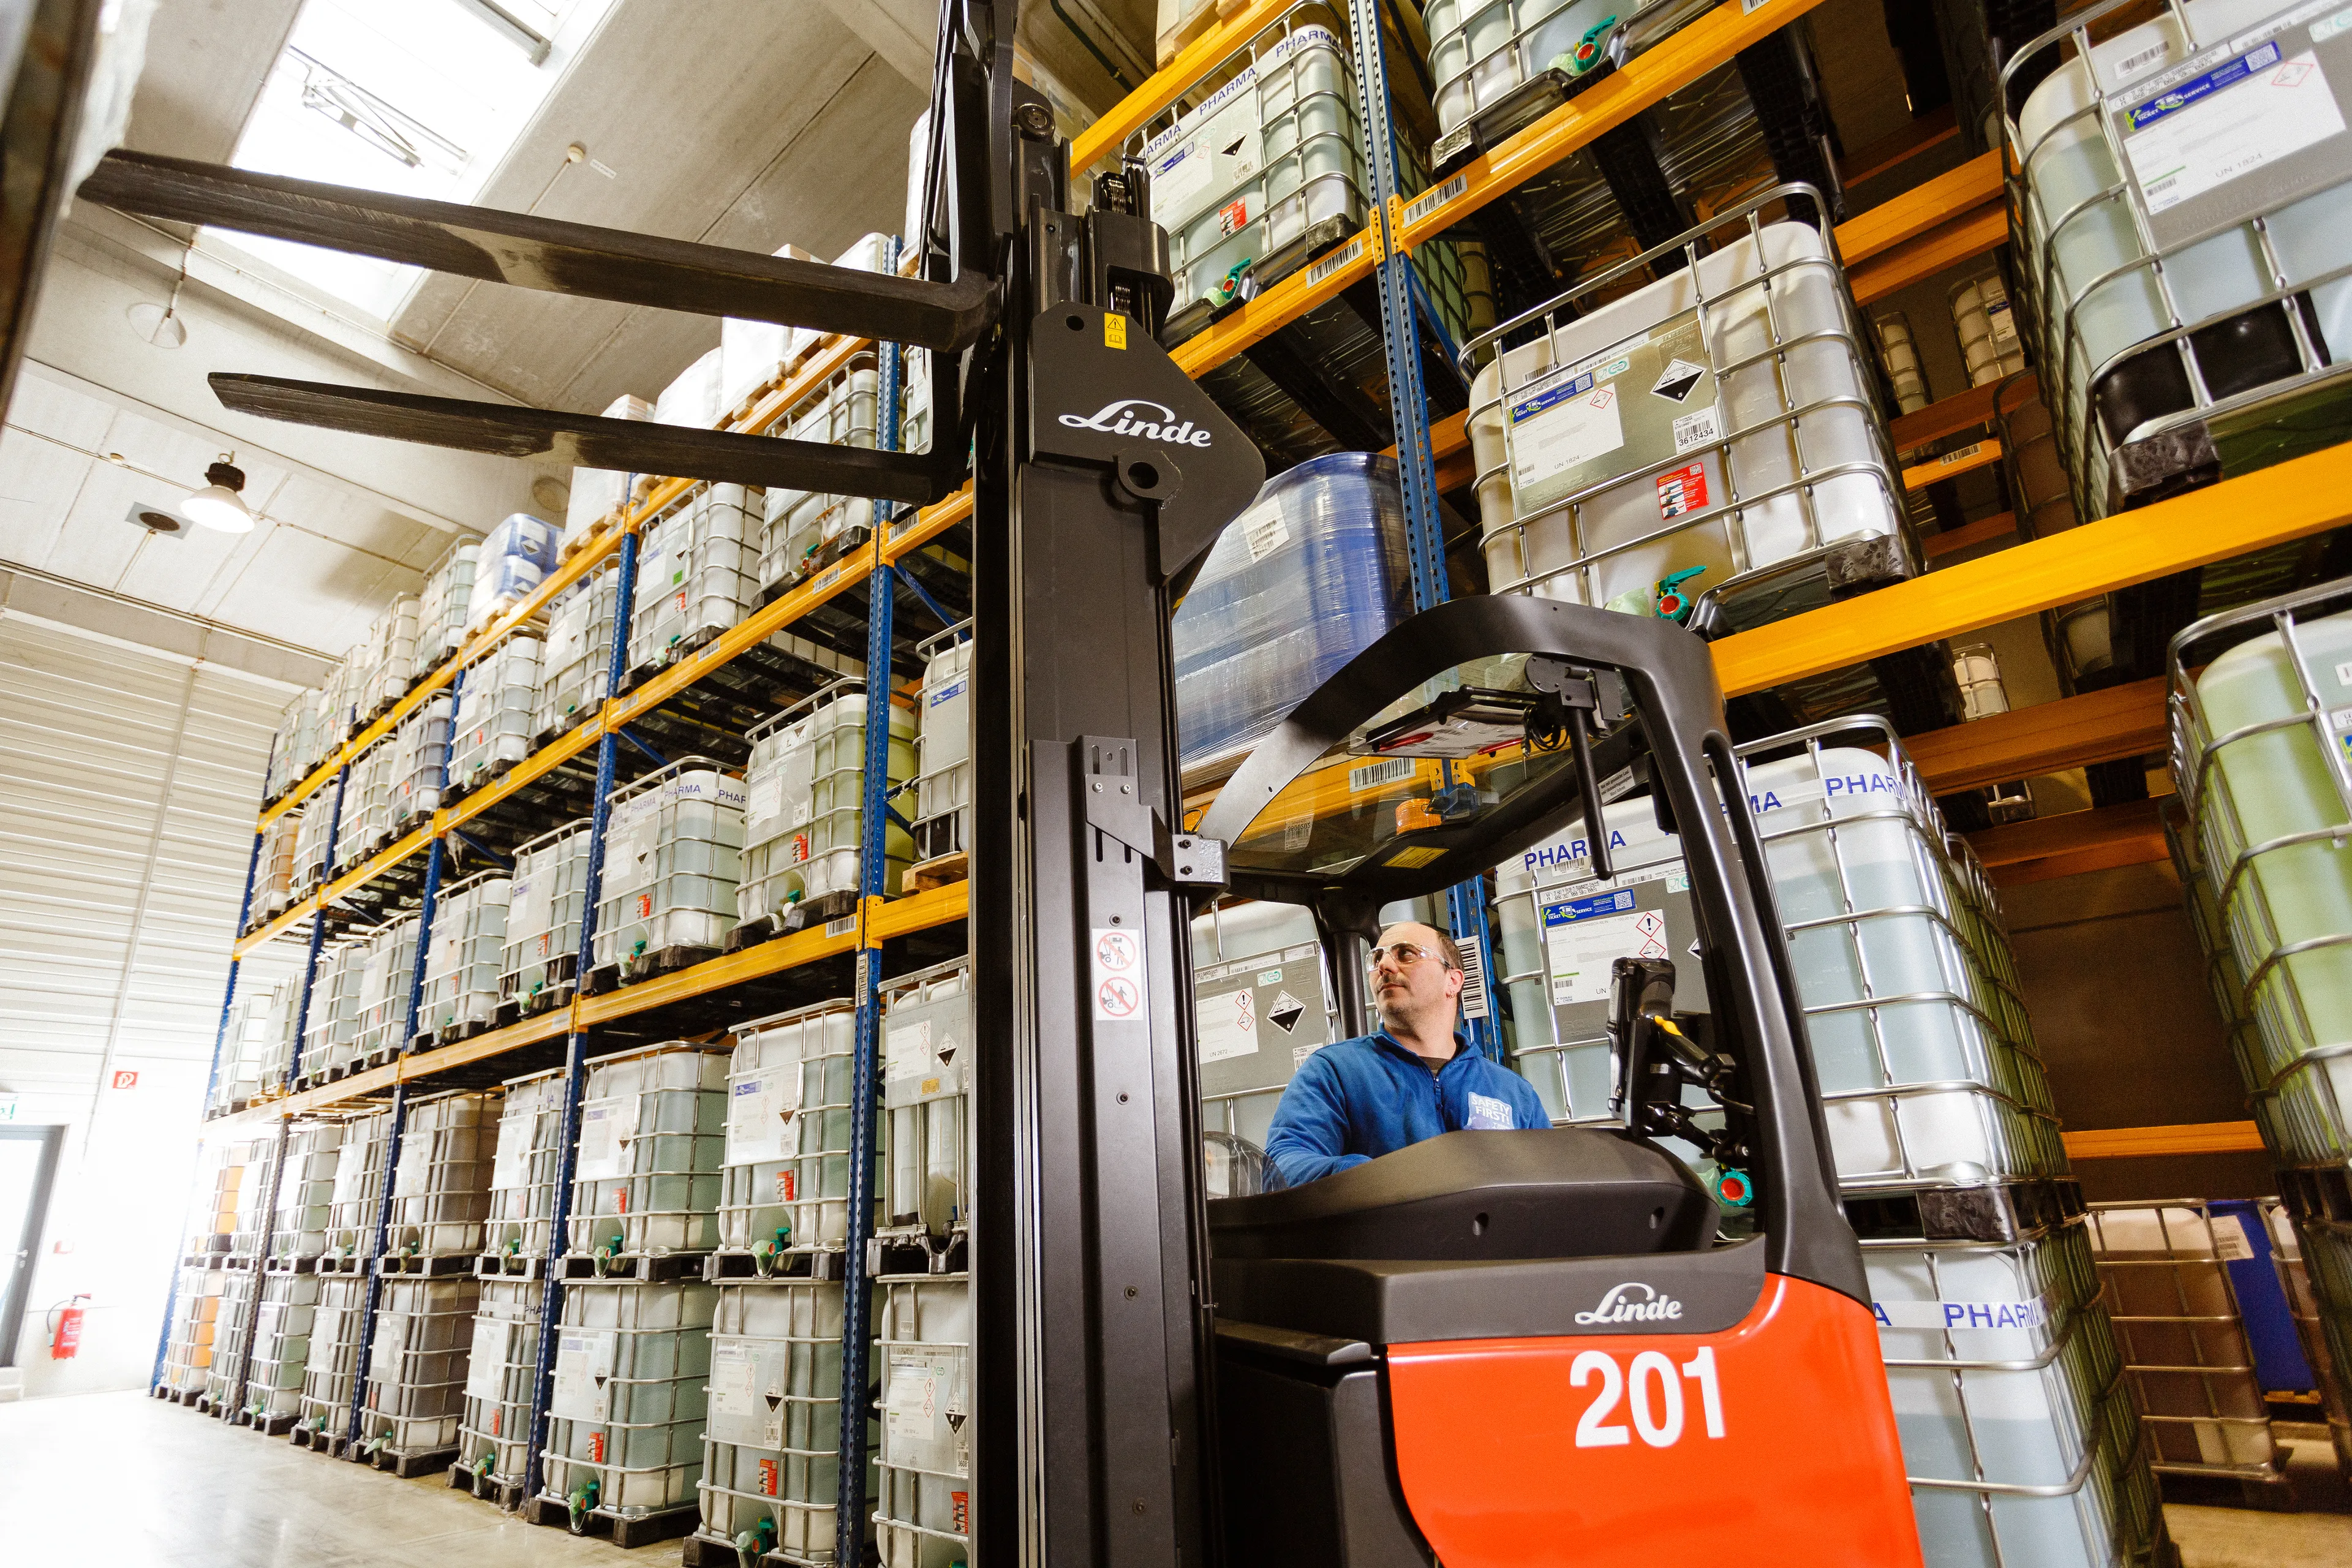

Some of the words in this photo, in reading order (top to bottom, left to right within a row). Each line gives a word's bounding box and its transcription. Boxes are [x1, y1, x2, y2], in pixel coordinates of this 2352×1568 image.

[1276, 29, 1340, 58] PHARMA
[1199, 67, 1256, 116] PHARMA
[2137, 108, 2159, 121] TICKET
[2183, 83, 2211, 99] SERVICE
[1144, 124, 1182, 157] ARMA
[2215, 166, 2233, 178] UN
[2237, 153, 2263, 168] 1824
[1540, 396, 1556, 406] SERVICE
[1058, 400, 1212, 447] Linde
[1679, 428, 1714, 447] 3612434
[1566, 455, 1580, 464] 1824
[664, 784, 701, 798] PHARMA
[718, 789, 747, 804] PHAR
[1825, 773, 1905, 800] PHARM
[1524, 830, 1627, 872] PHARA
[1471, 1094, 1510, 1115] SAFETY
[1475, 1106, 1510, 1125] FIRST!
[525, 1305, 542, 1315] PHA
[1574, 1282, 1683, 1324] Linde
[1570, 1346, 1726, 1448] 201
